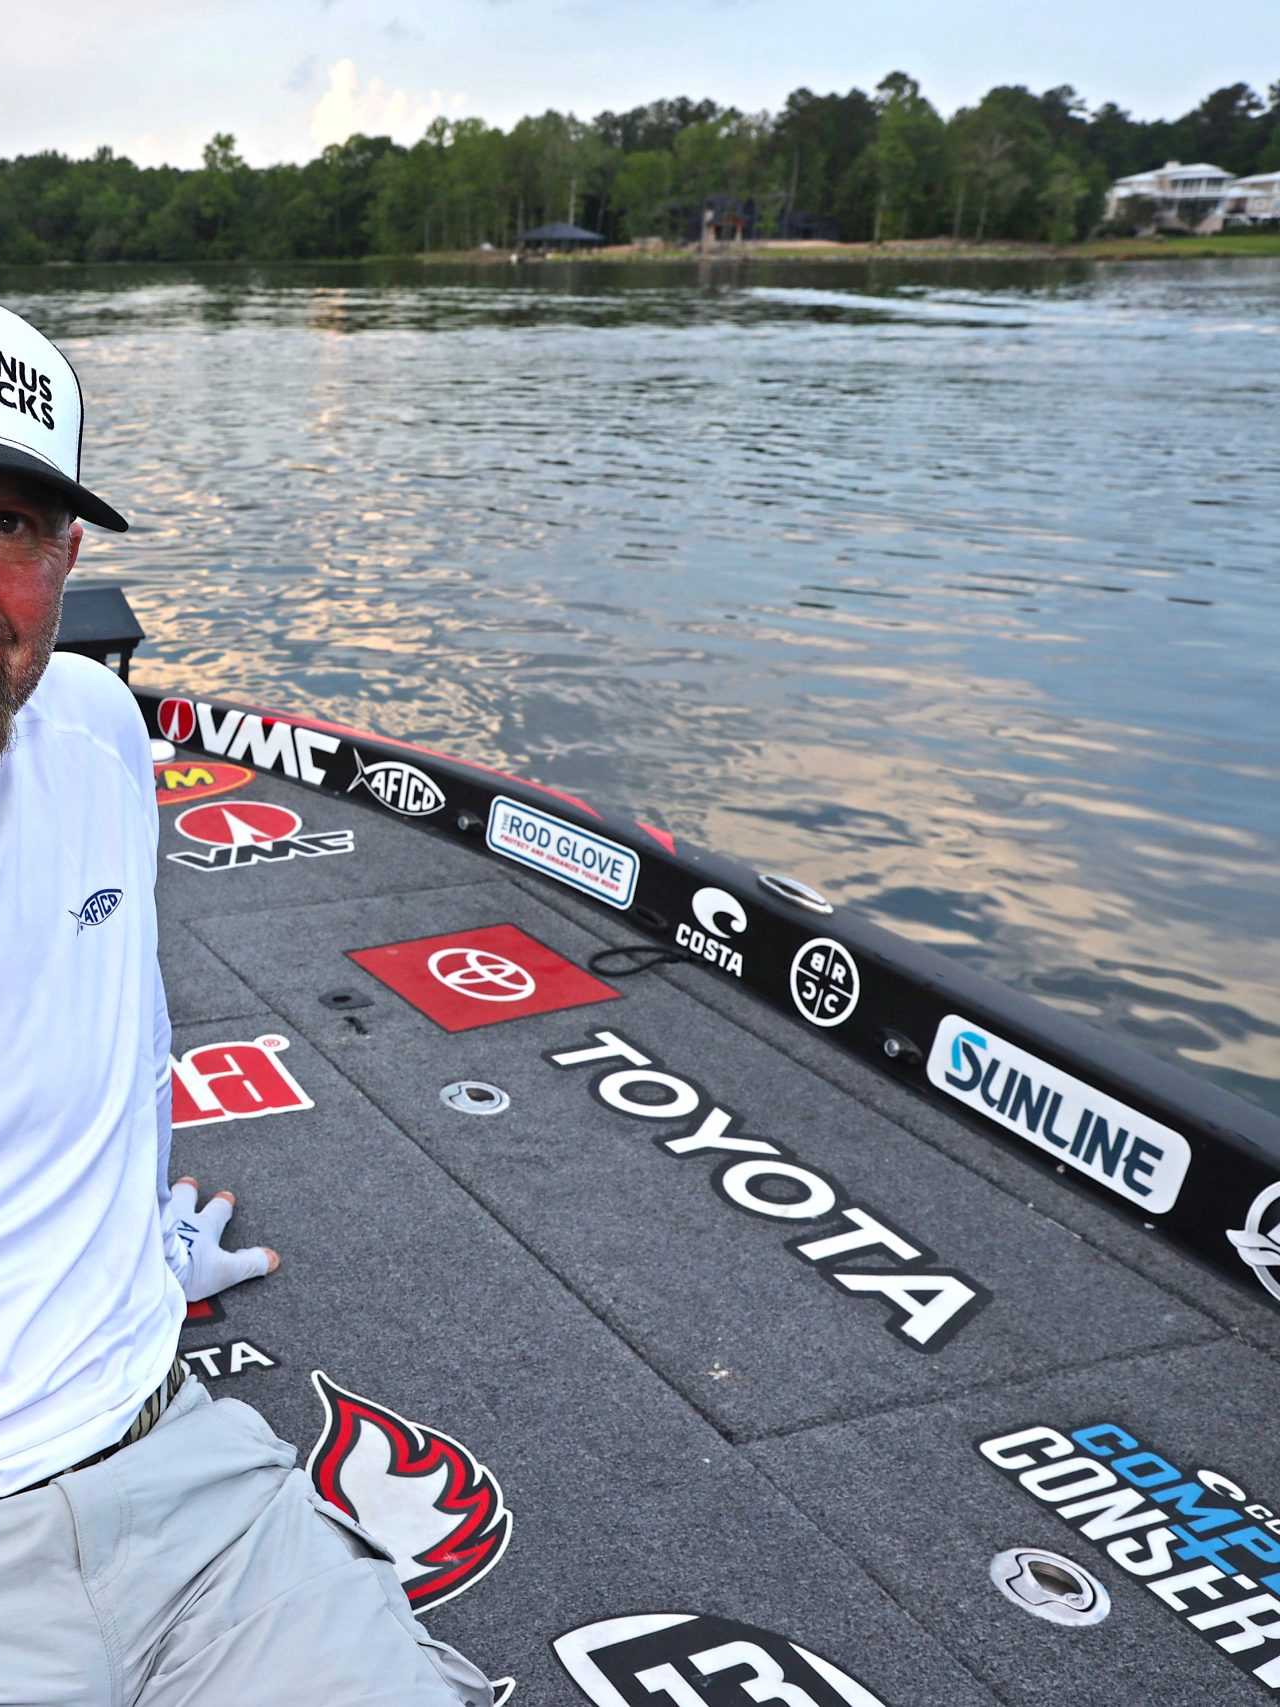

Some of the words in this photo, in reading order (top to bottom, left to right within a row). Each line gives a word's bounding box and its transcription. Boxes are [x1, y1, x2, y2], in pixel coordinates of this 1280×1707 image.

[196, 702, 341, 785] VMC
[365, 761, 446, 812] AFTCO
[167, 830, 354, 872] VMC
[500, 834, 530, 852] PROTECT
[530, 848, 545, 857] AND
[582, 869, 599, 883] YOUR
[509, 816, 551, 849] ROD
[556, 836, 624, 882] GLOVE
[79, 889, 122, 924] AFTCO
[675, 922, 745, 978] COSTA
[945, 1031, 1165, 1197] SUNLINE
[551, 1031, 977, 1345] TOYOTA
